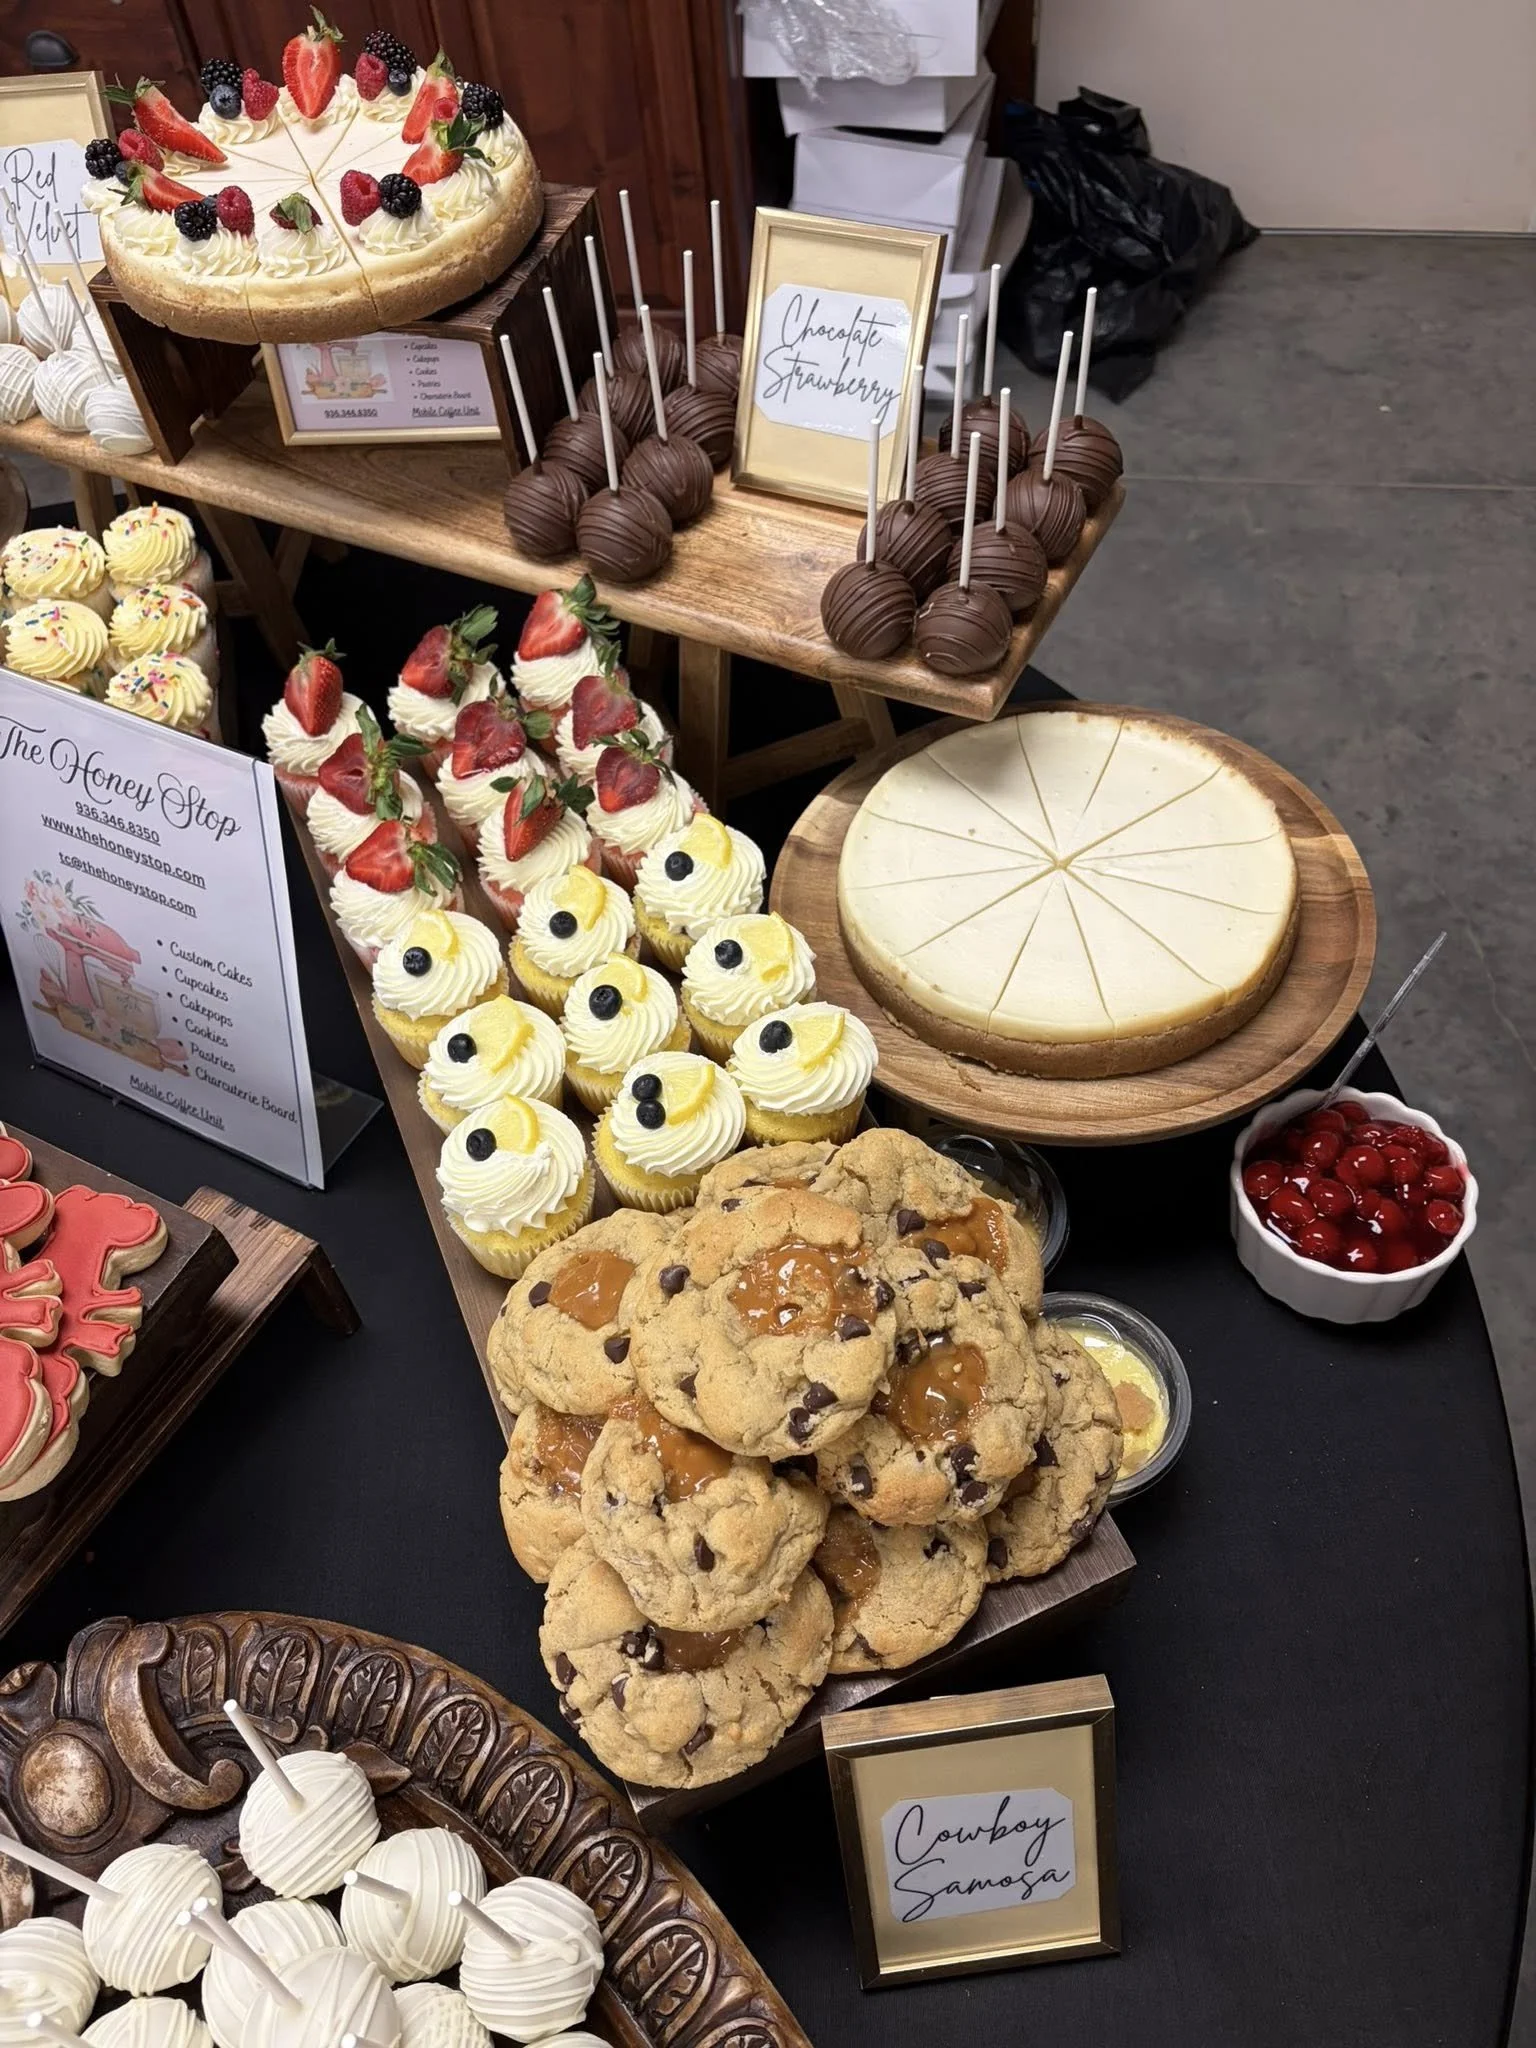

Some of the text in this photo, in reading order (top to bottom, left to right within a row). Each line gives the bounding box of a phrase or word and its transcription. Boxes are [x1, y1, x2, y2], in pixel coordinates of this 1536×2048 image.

[4, 147, 58, 211] Red
[6, 201, 91, 258] Velvet
[782, 294, 896, 366] Chocolate
[412, 405, 480, 418] Mobile Coffee Unit
[763, 345, 902, 425] Strawberry
[0, 715, 241, 841] The Honey Stop
[41, 814, 207, 890] www.thehoneystop.com
[75, 801, 161, 846] 936.346.8350
[58, 852, 197, 918] tc@thehoneystop.com
[170, 941, 253, 988] Custom Cakes
[174, 968, 229, 1002] Cupcakes
[179, 994, 233, 1027] Cakepops
[185, 1019, 229, 1048] Cookies
[190, 1042, 236, 1073] Pastries
[195, 1066, 259, 1106] Charcuterie
[129, 1074, 225, 1131] Mobile Coffee Unit
[895, 1795, 1066, 1867] Cowboy
[894, 1858, 1070, 1923] Samosa
